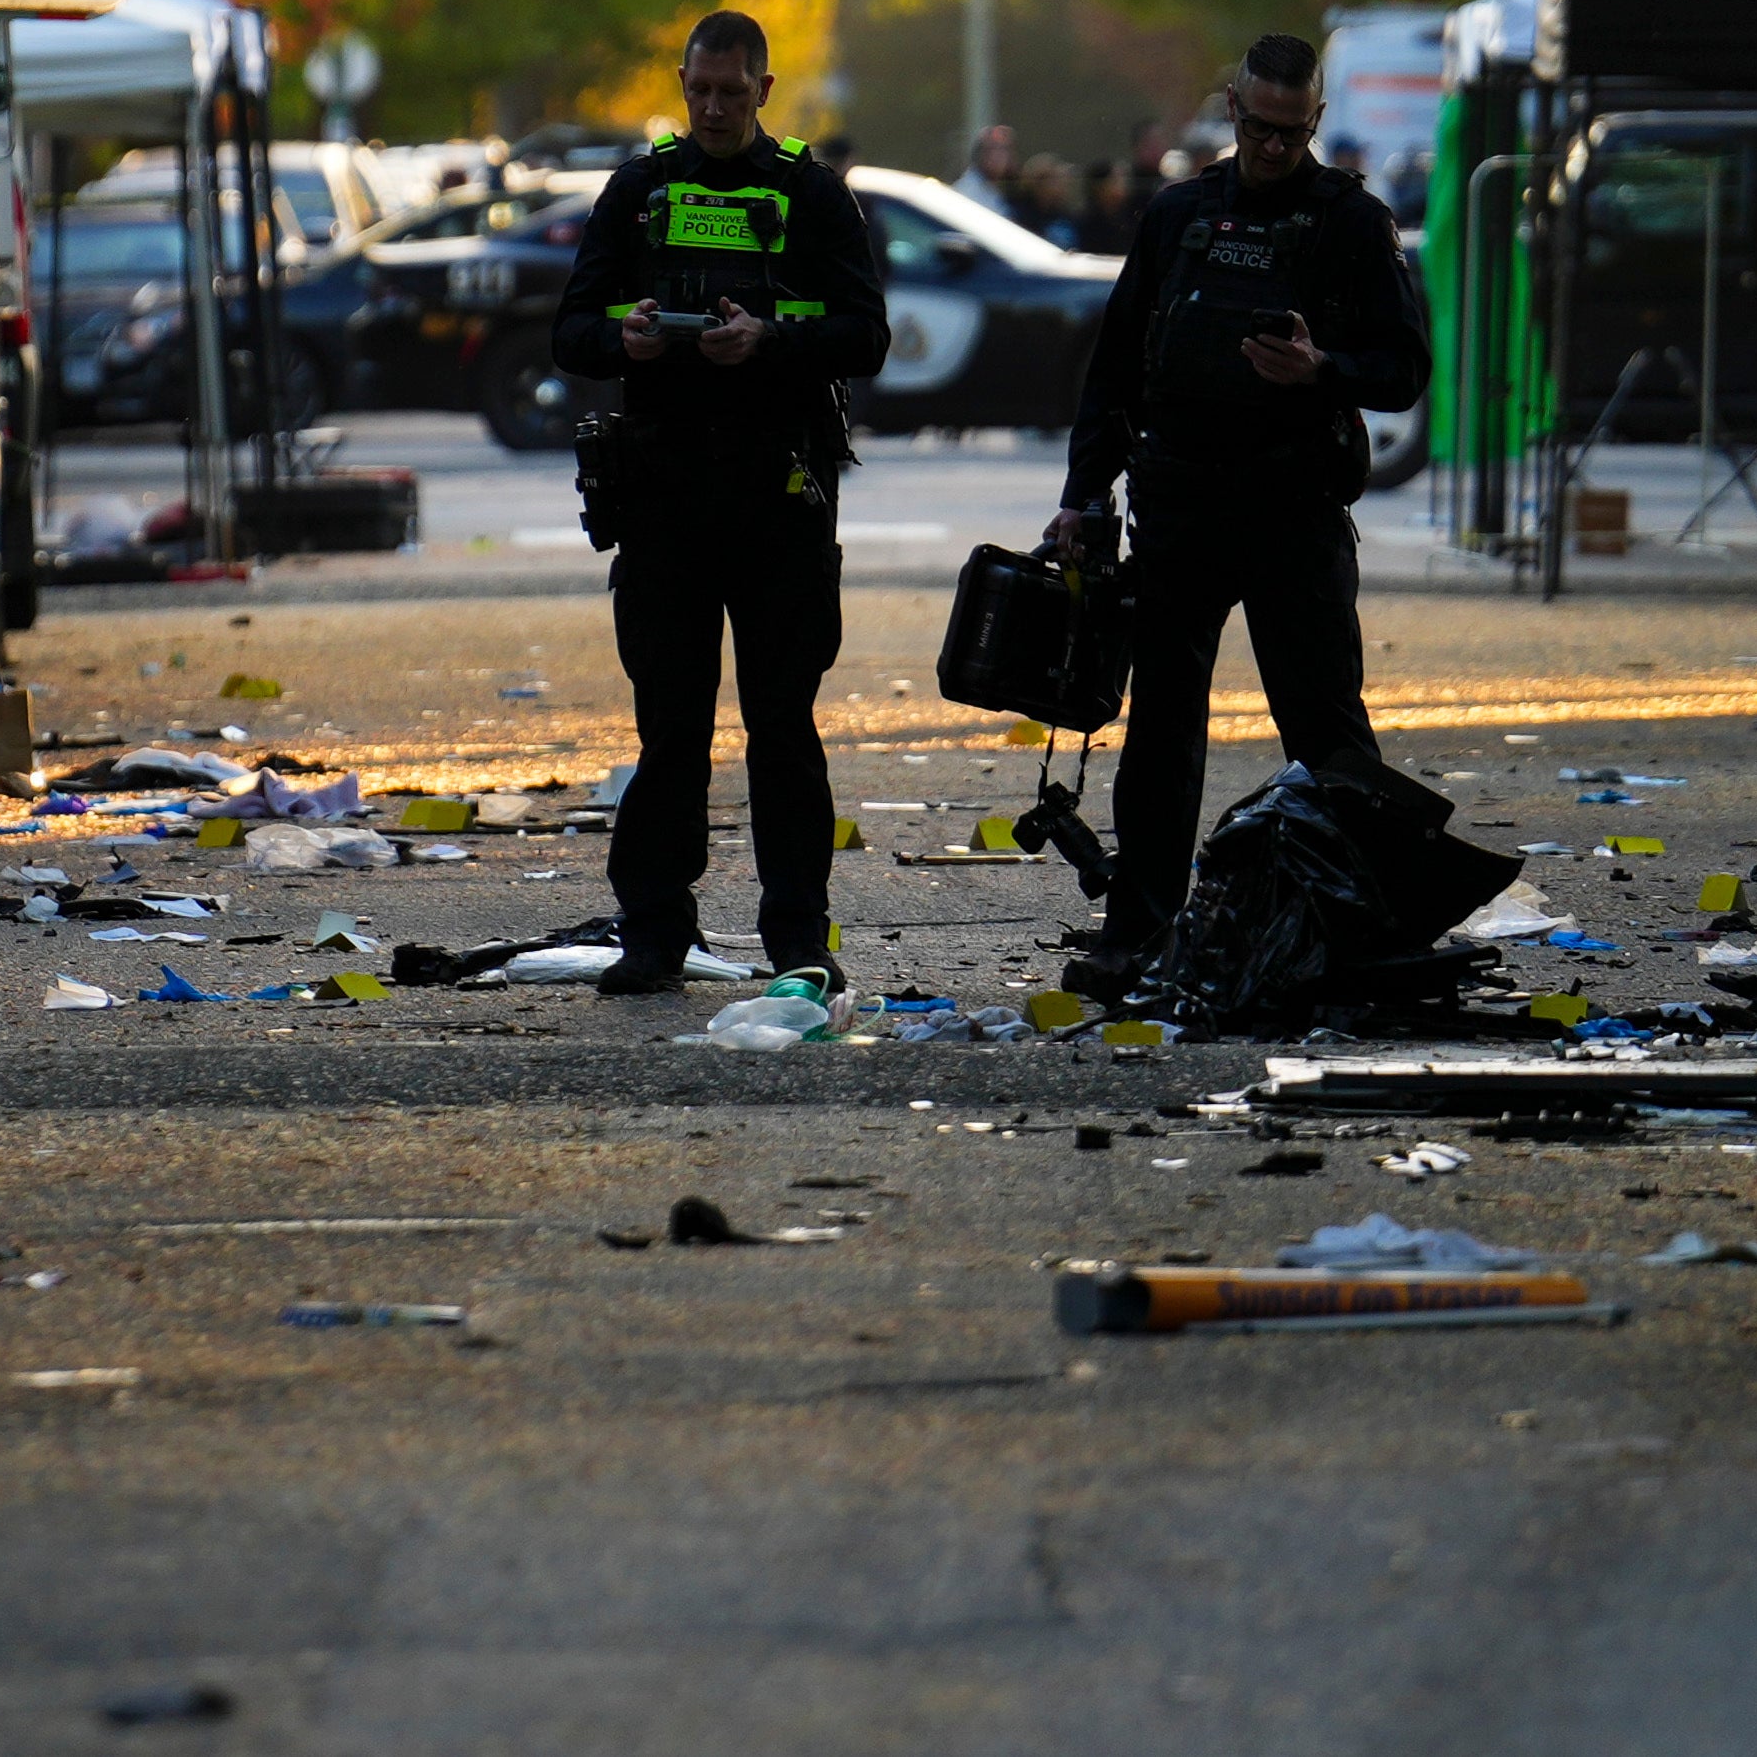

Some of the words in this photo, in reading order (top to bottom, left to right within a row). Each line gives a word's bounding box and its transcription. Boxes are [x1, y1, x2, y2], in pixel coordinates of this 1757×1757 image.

[685, 212, 748, 224] VANCOUVER
[683, 221, 750, 238] POLICE
[1213, 239, 1274, 255] VANCOUVER
[1207, 248, 1274, 269] POLICE
